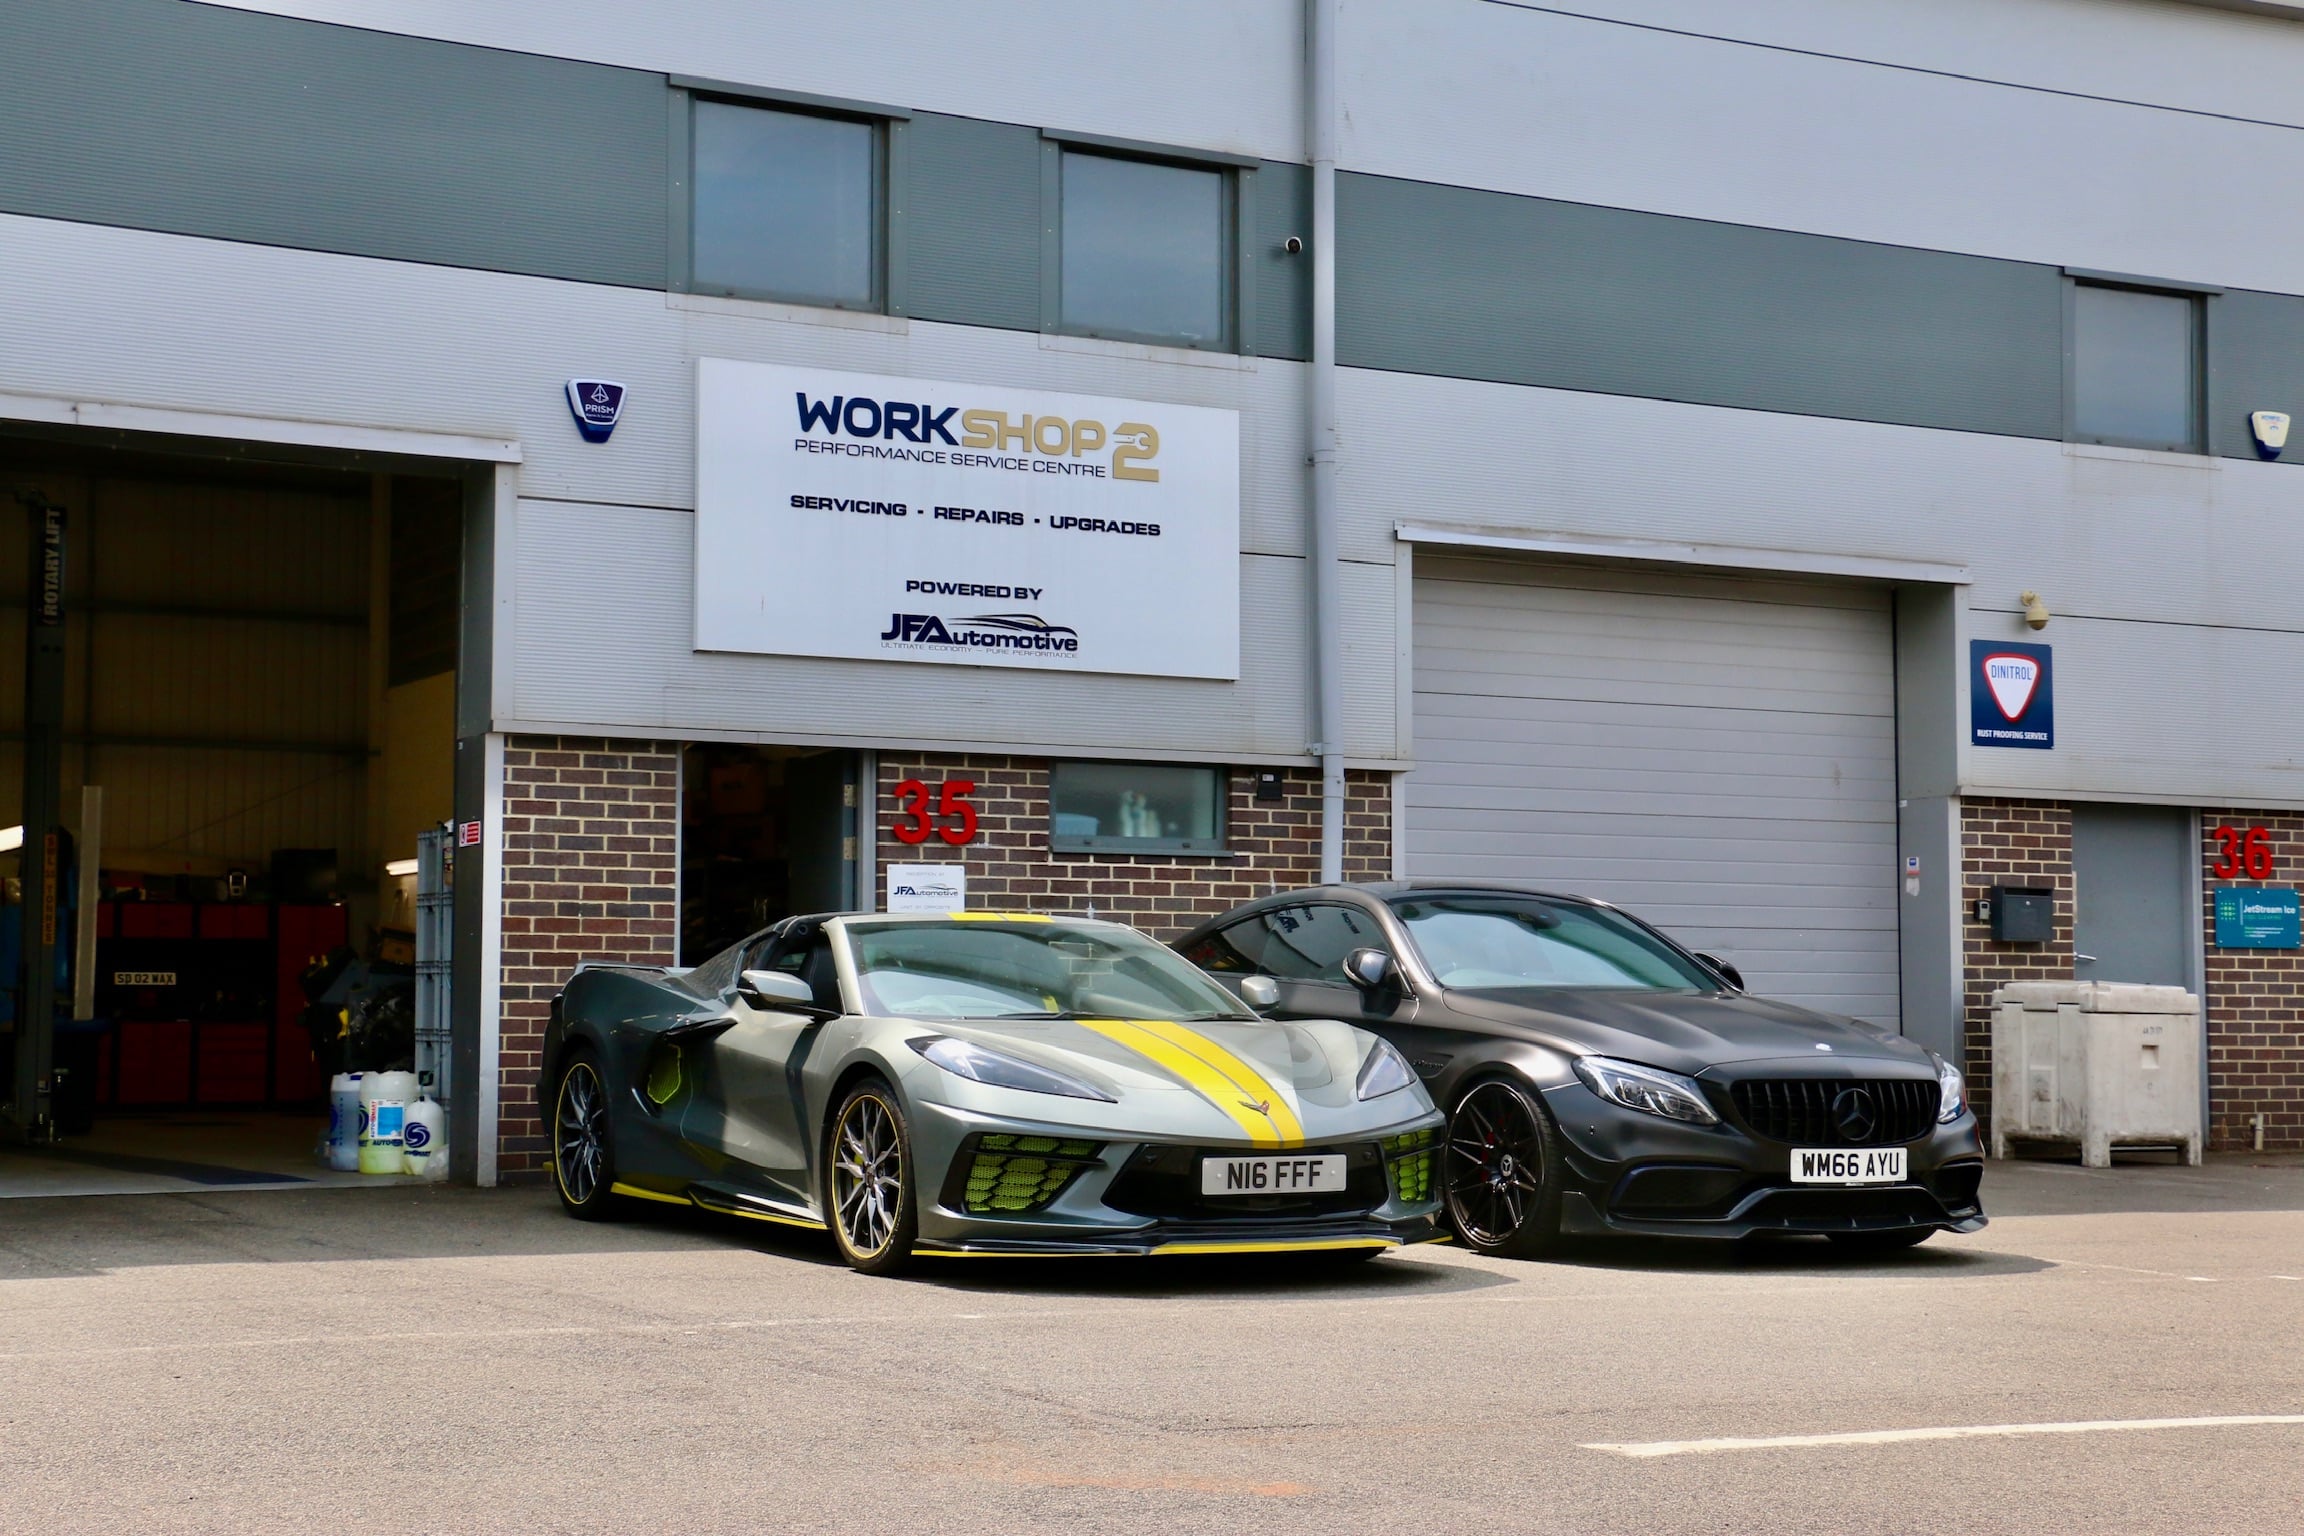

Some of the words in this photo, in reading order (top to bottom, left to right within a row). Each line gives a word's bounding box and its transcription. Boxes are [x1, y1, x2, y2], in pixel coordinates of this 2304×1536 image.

[585, 403, 615, 415] PRISM
[795, 391, 1107, 458] WORKSHOP
[1112, 421, 1160, 483] 2
[795, 439, 947, 464] PERFORMANCE
[951, 453, 1029, 472] SERVICE
[1032, 460, 1106, 478] CENTRE
[45, 507, 61, 545] LIFT
[790, 494, 907, 517] SERVICING
[934, 506, 1024, 526] REPAIRS
[1049, 514, 1161, 537] UPGRADES
[44, 547, 59, 617] ROTARY
[906, 579, 1011, 599] POWERED
[1014, 586, 1043, 601] BY
[881, 642, 924, 650] ULTIMATE
[928, 645, 972, 653] ECONOMY
[1013, 650, 1078, 659] PERFORMANCE
[1991, 664, 2032, 680] DINITROL
[1976, 729, 1993, 738] RUST
[1993, 729, 2024, 739] PROOFING
[2024, 731, 2048, 740] SERVICE
[892, 779, 979, 846] 35
[2213, 825, 2274, 880] 36
[2243, 904, 2283, 914] JetStream
[2284, 905, 2296, 914] Ice
[1227, 1162, 1268, 1190] N16
[1275, 1160, 1324, 1188] FFF
[1802, 1153, 1860, 1177] WM66
[1865, 1152, 1900, 1177] AYU
